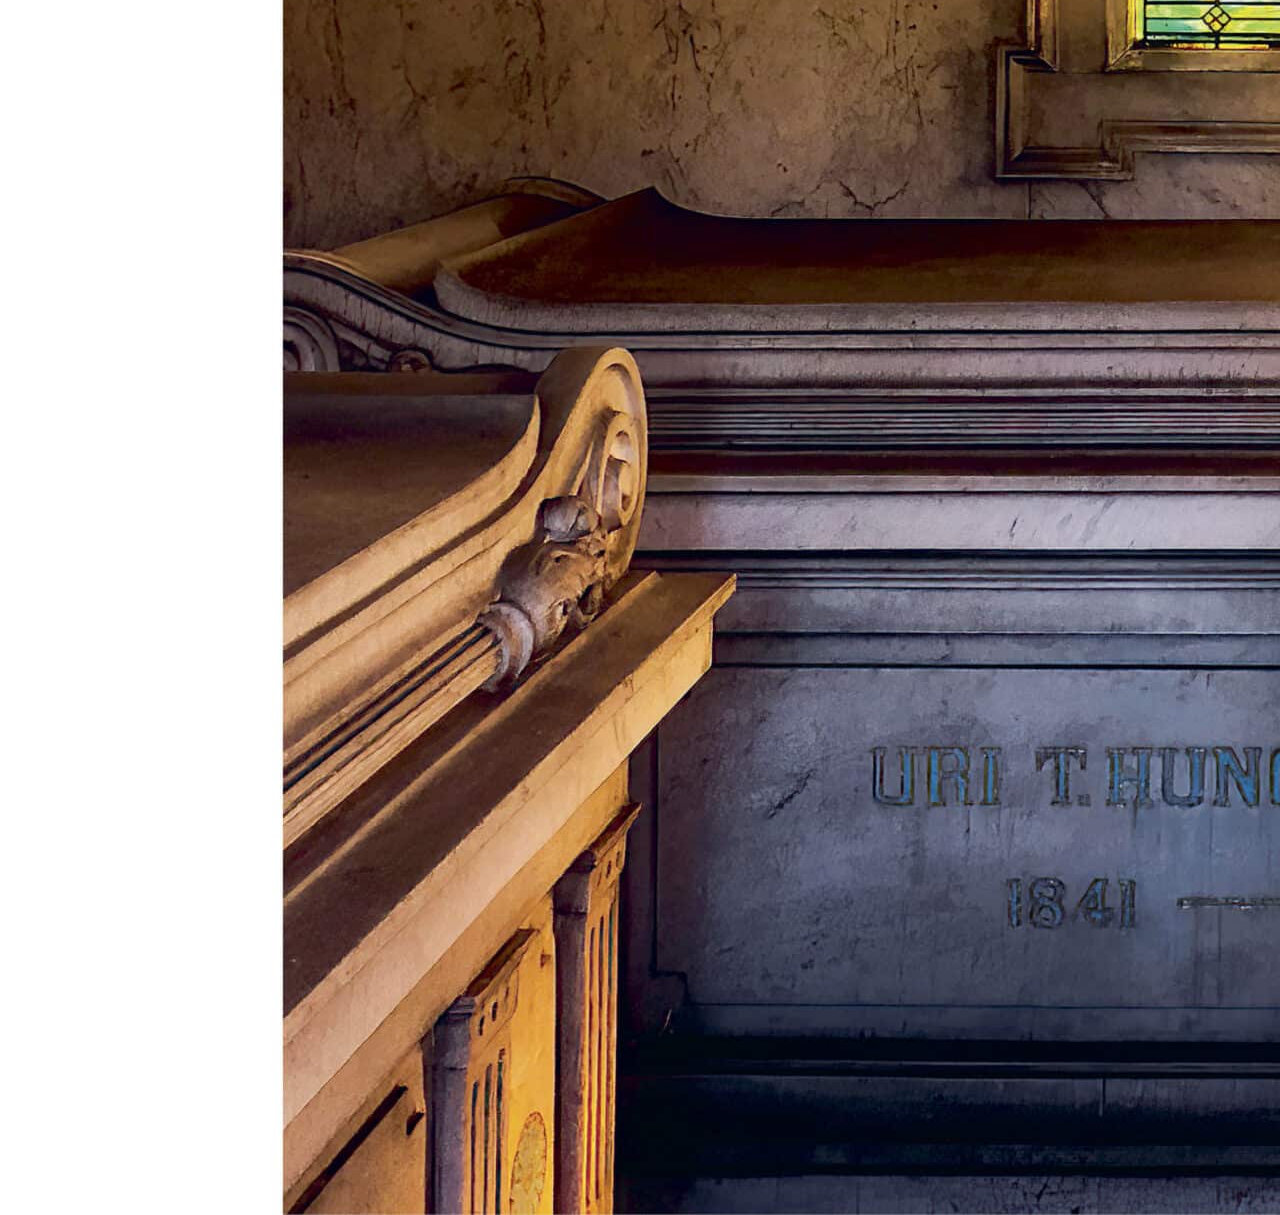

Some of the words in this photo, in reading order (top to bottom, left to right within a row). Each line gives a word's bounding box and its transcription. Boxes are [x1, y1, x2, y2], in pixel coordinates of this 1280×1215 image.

[871, 745, 1001, 806] URI
[1034, 746, 1089, 806] T.
[1006, 877, 1138, 929] 1841
